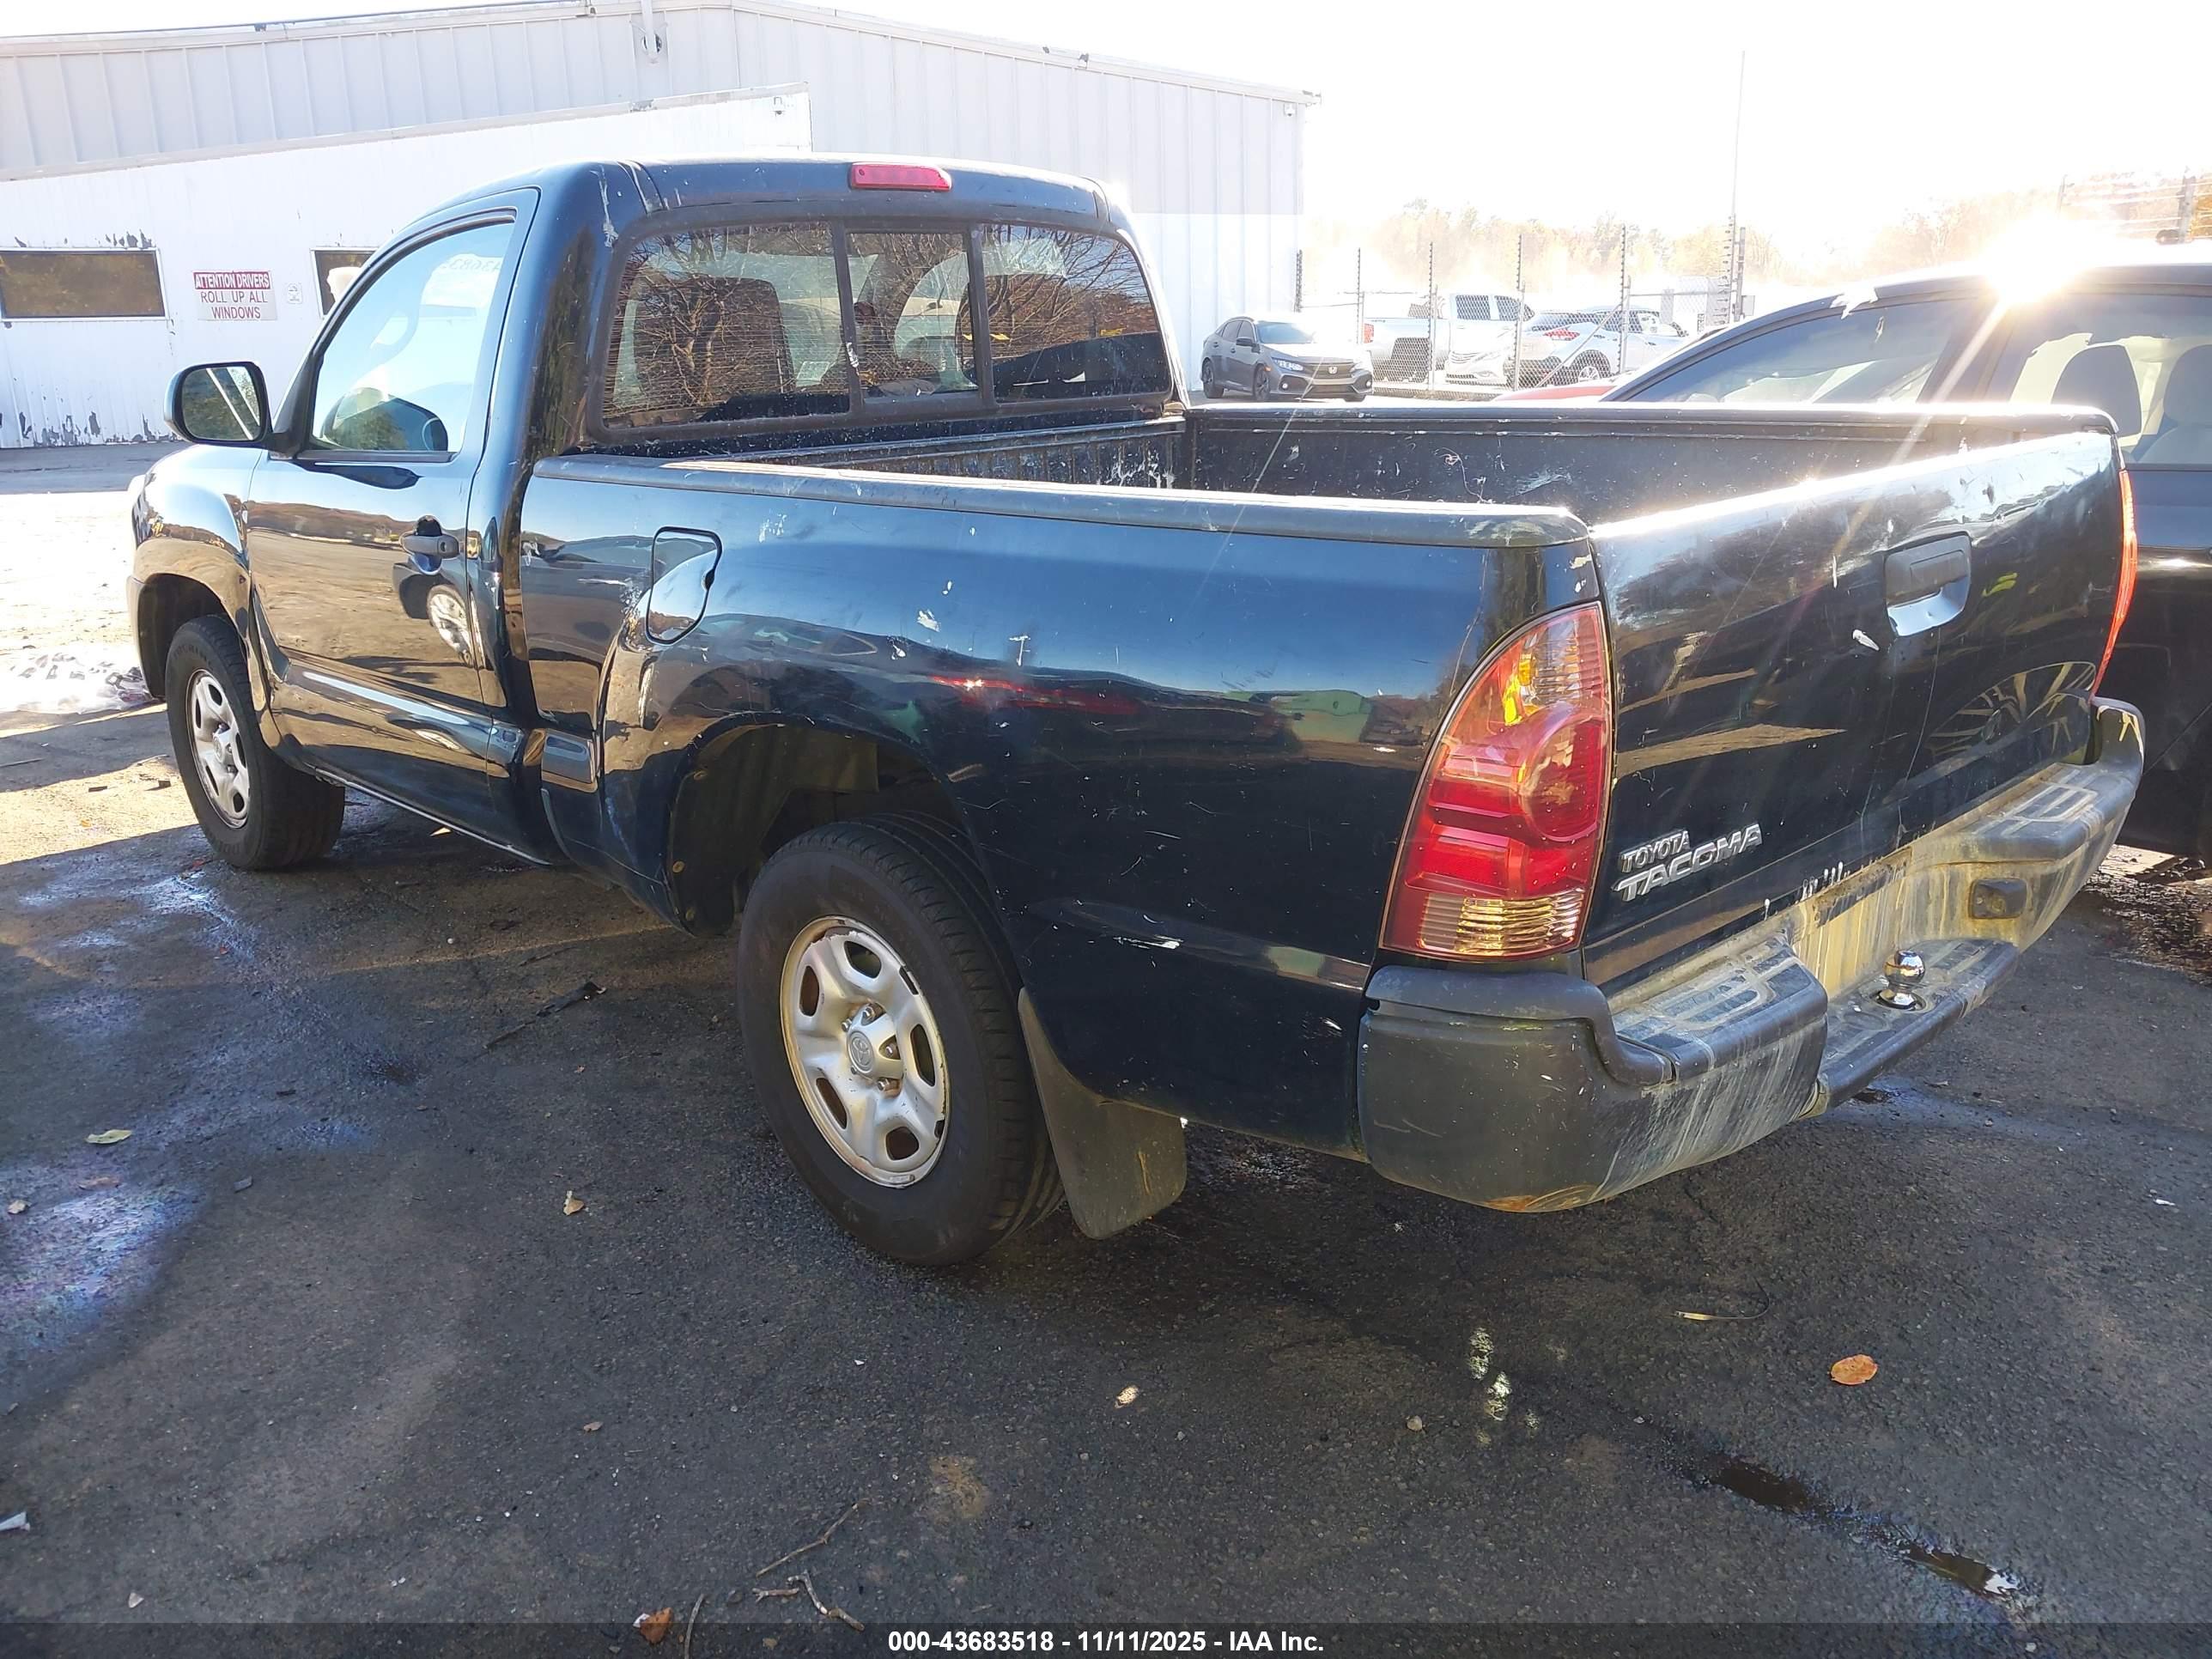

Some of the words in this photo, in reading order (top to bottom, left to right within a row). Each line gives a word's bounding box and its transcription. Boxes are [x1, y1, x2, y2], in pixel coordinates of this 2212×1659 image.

[195, 273, 235, 289] ATTENTION
[236, 273, 270, 289] DRIVERS
[201, 291, 228, 303] ROLL
[232, 291, 245, 303] UP
[249, 291, 268, 303] ALL
[211, 307, 261, 319] WINDOWS
[1620, 830, 1691, 873] TOYOTA
[1613, 823, 1763, 902] TACOMA
